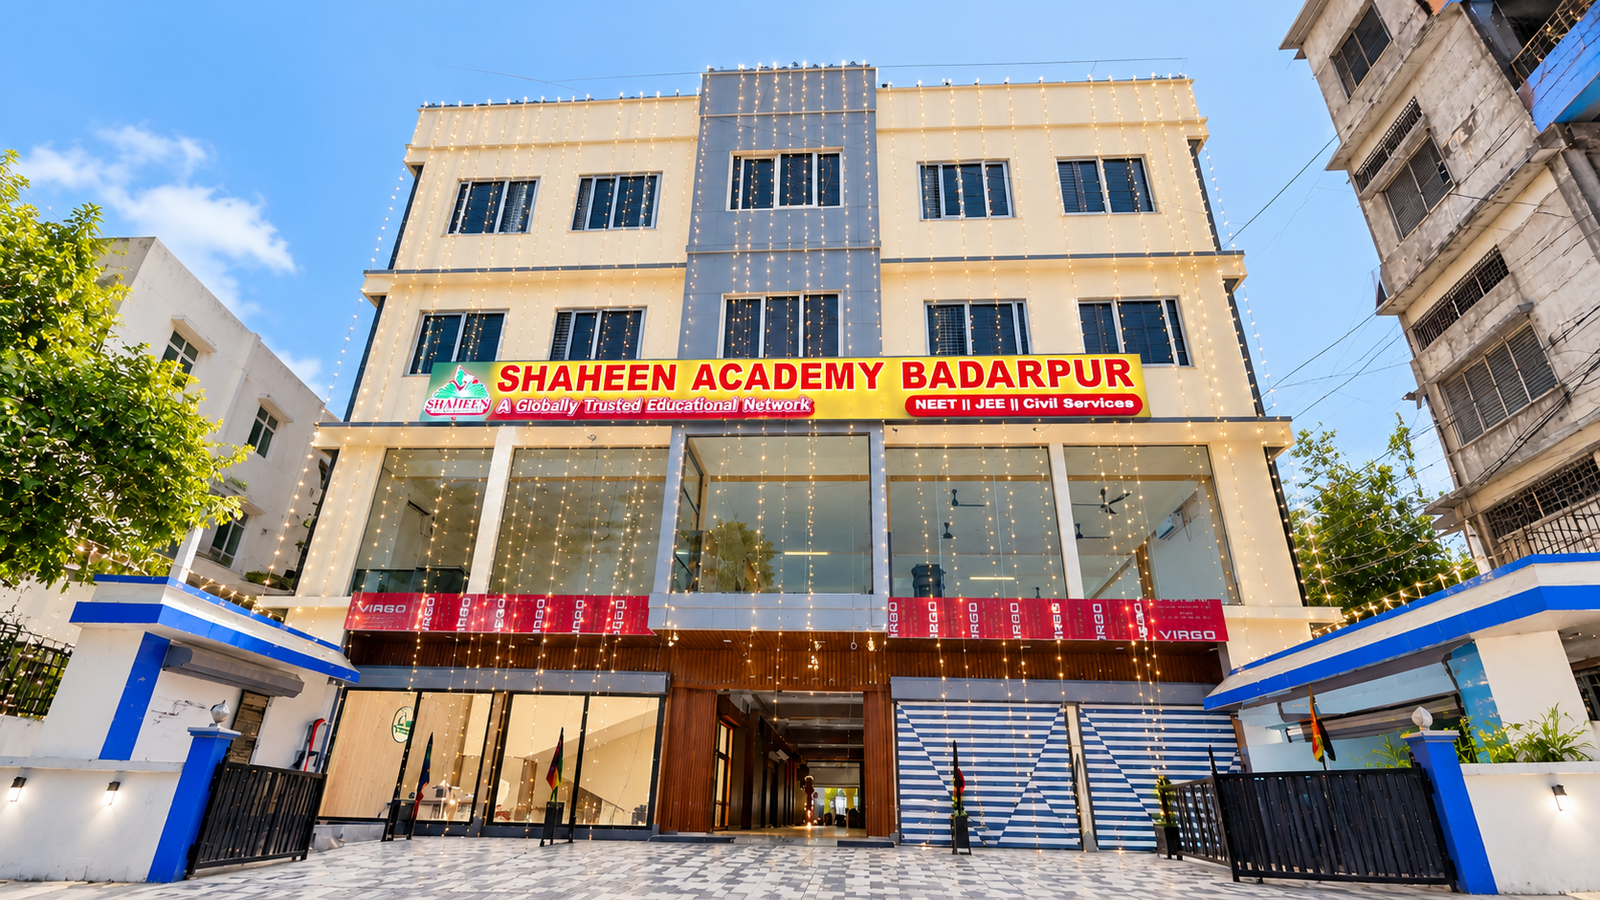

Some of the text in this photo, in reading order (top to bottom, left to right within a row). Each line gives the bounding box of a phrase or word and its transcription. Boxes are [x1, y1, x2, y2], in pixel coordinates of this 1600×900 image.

[497, 358, 1135, 392] SHAHEEN ACADEMY BADARPUR
[497, 397, 811, 415] A Globally Trusted Educational Network
[915, 399, 957, 409] NEET
[975, 398, 1006, 409] JEE
[1023, 398, 1058, 409] Civil
[1063, 398, 1134, 408] Services
[1159, 630, 1216, 640] VIRGO
